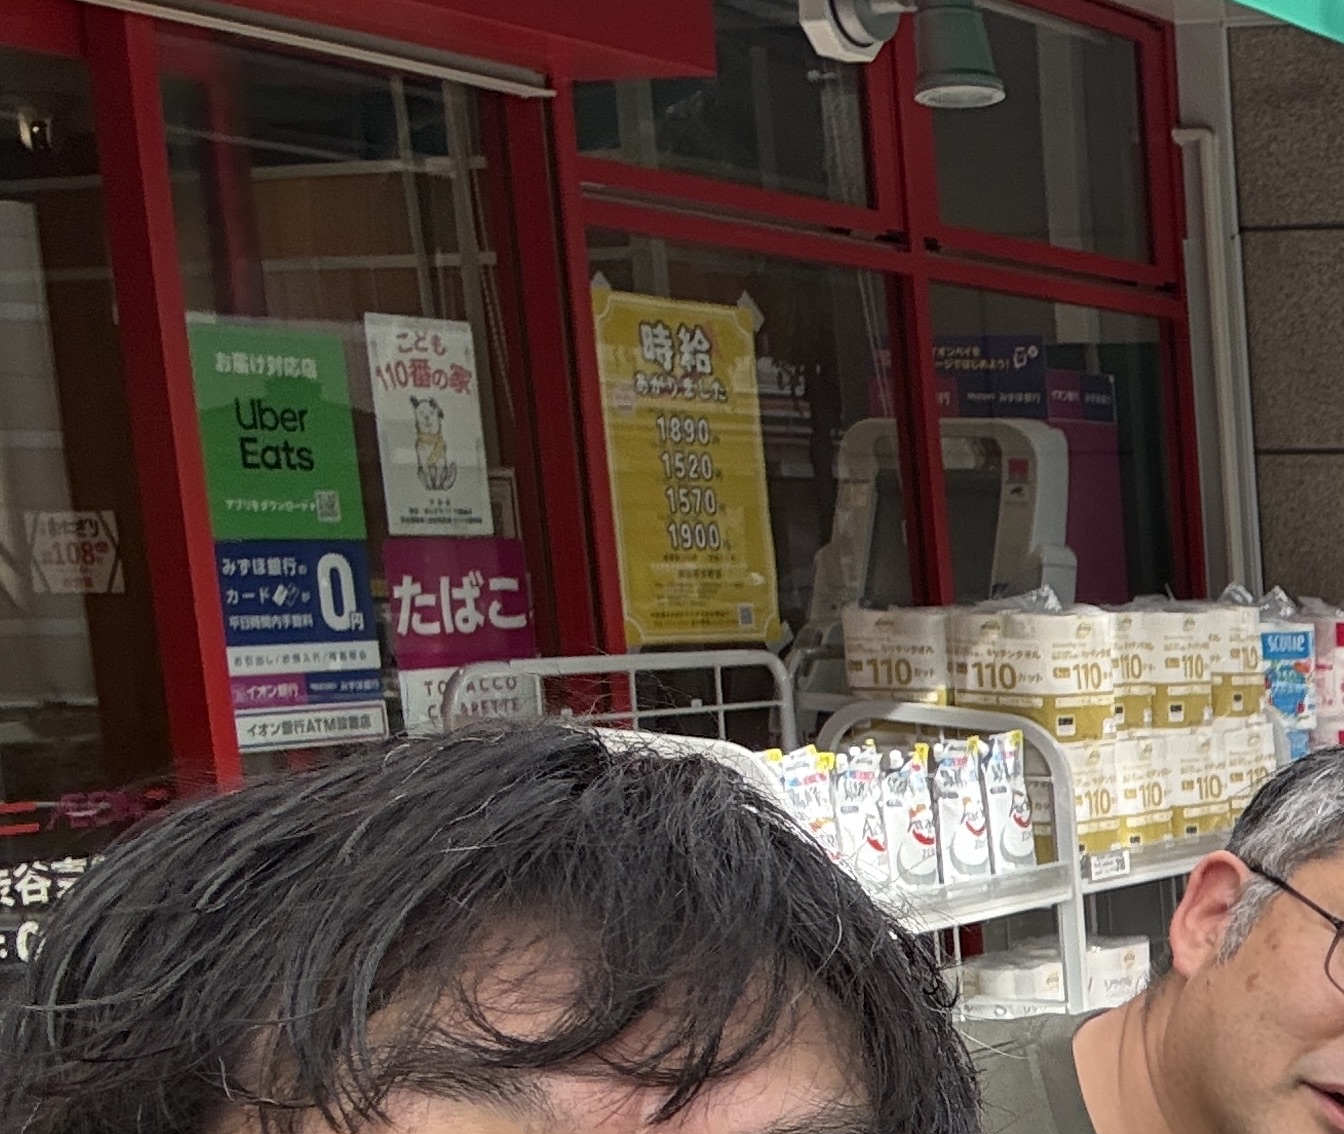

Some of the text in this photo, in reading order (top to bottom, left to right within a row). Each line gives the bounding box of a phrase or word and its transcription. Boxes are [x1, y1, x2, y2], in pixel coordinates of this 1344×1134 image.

[396, 331, 446, 356] こども
[639, 320, 713, 375] 時給
[376, 358, 473, 395] 110番の家
[234, 397, 308, 431] Uber
[239, 436, 315, 471] Eats
[393, 570, 528, 636] たばこ
[866, 658, 912, 686] 110
[971, 662, 1017, 690] 110
[1073, 662, 1102, 690] 110
[1119, 653, 1142, 680] 110
[1182, 653, 1204, 680] 110
[423, 677, 518, 697] TOACCO
[1140, 781, 1164, 807] 110
[1197, 774, 1223, 800] 110
[1085, 788, 1111, 815] 110
